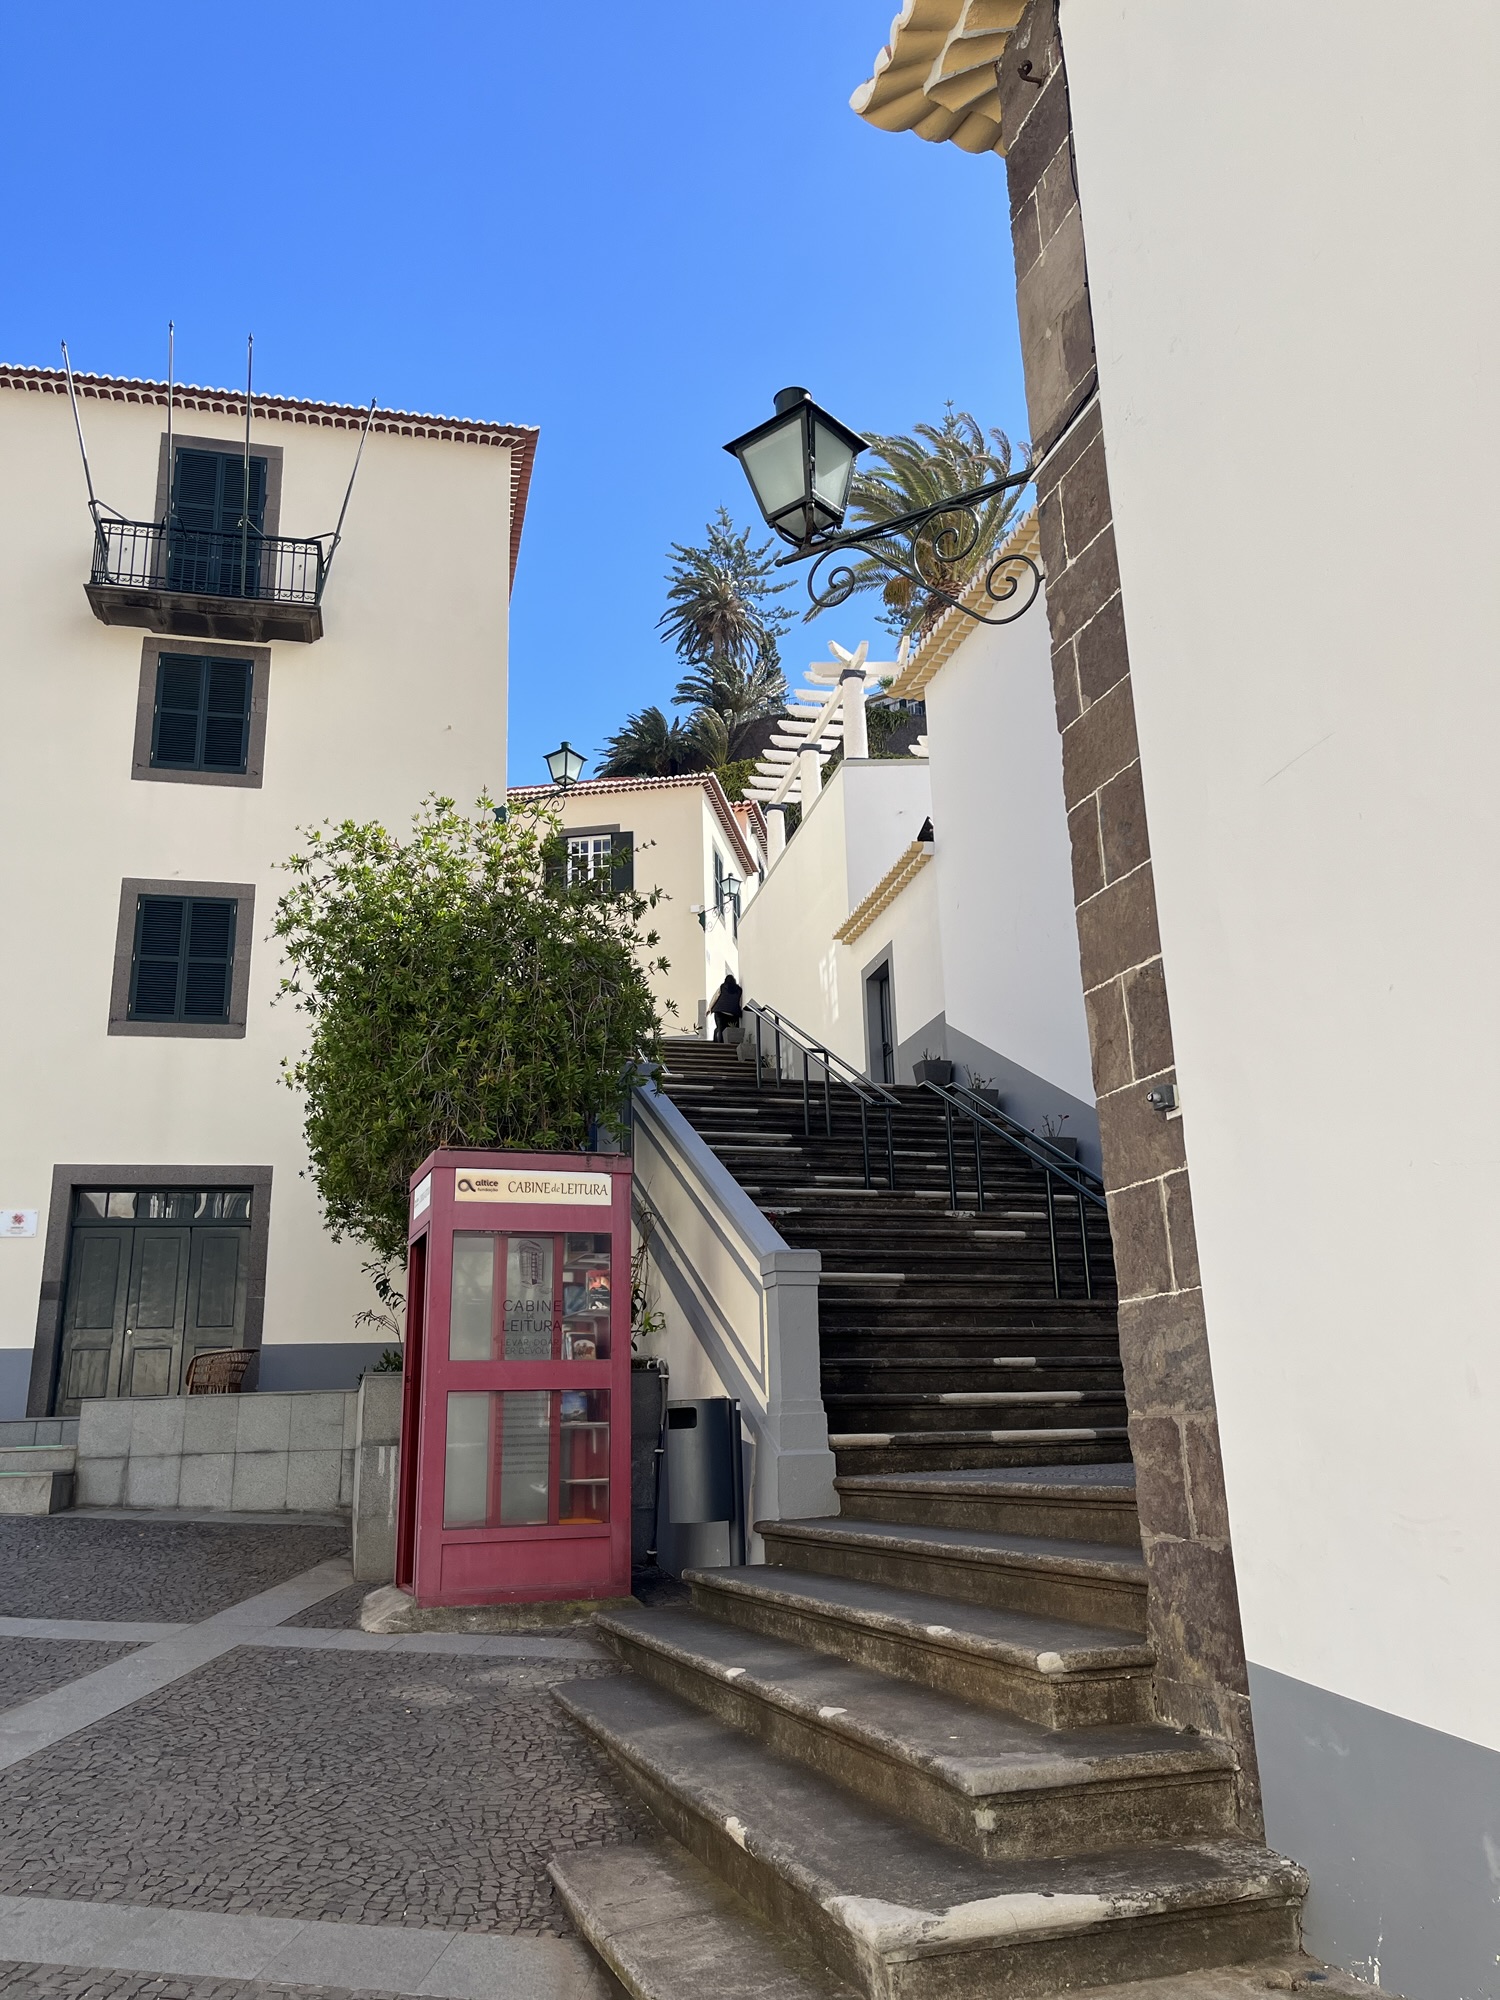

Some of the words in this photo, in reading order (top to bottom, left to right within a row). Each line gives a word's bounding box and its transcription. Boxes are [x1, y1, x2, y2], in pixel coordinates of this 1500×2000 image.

[475, 1179, 498, 1187] altice
[508, 1181, 550, 1194] CABINE
[560, 1182, 608, 1196] LEITURA
[502, 1300, 562, 1312] CABINE
[502, 1320, 562, 1332] LEITURA
